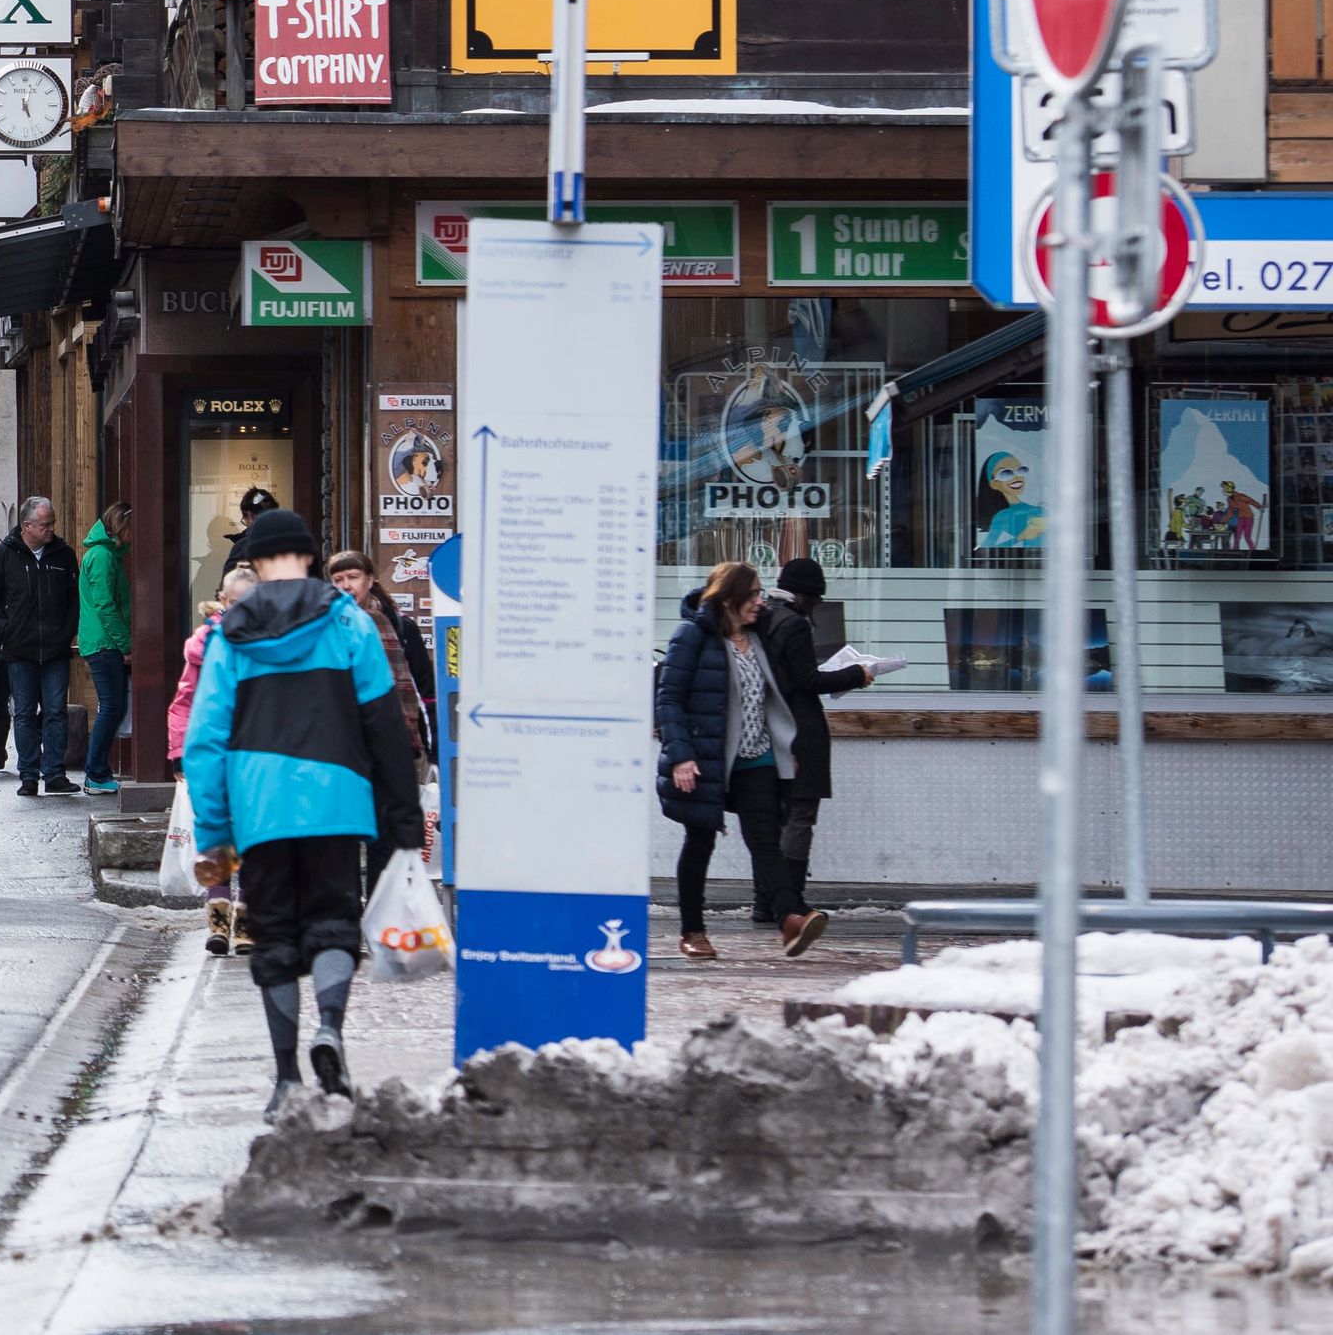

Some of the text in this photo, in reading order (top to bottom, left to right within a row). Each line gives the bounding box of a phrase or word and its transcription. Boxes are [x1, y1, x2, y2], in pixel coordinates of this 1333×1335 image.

[790, 214, 939, 274] 1 Stunde
[661, 261, 717, 276] ENTER
[834, 248, 905, 277] Hour
[1260, 260, 1333, 291] 027
[259, 300, 355, 318] FUJIFILM
[705, 346, 830, 394] ALPINE
[210, 400, 265, 412] ROLEX
[400, 398, 446, 407] FUJIFILM
[381, 417, 453, 447] ALPINE
[383, 496, 450, 510] PHOTO
[709, 485, 826, 509] PHOTO
[401, 531, 446, 541] FUJIFILM
